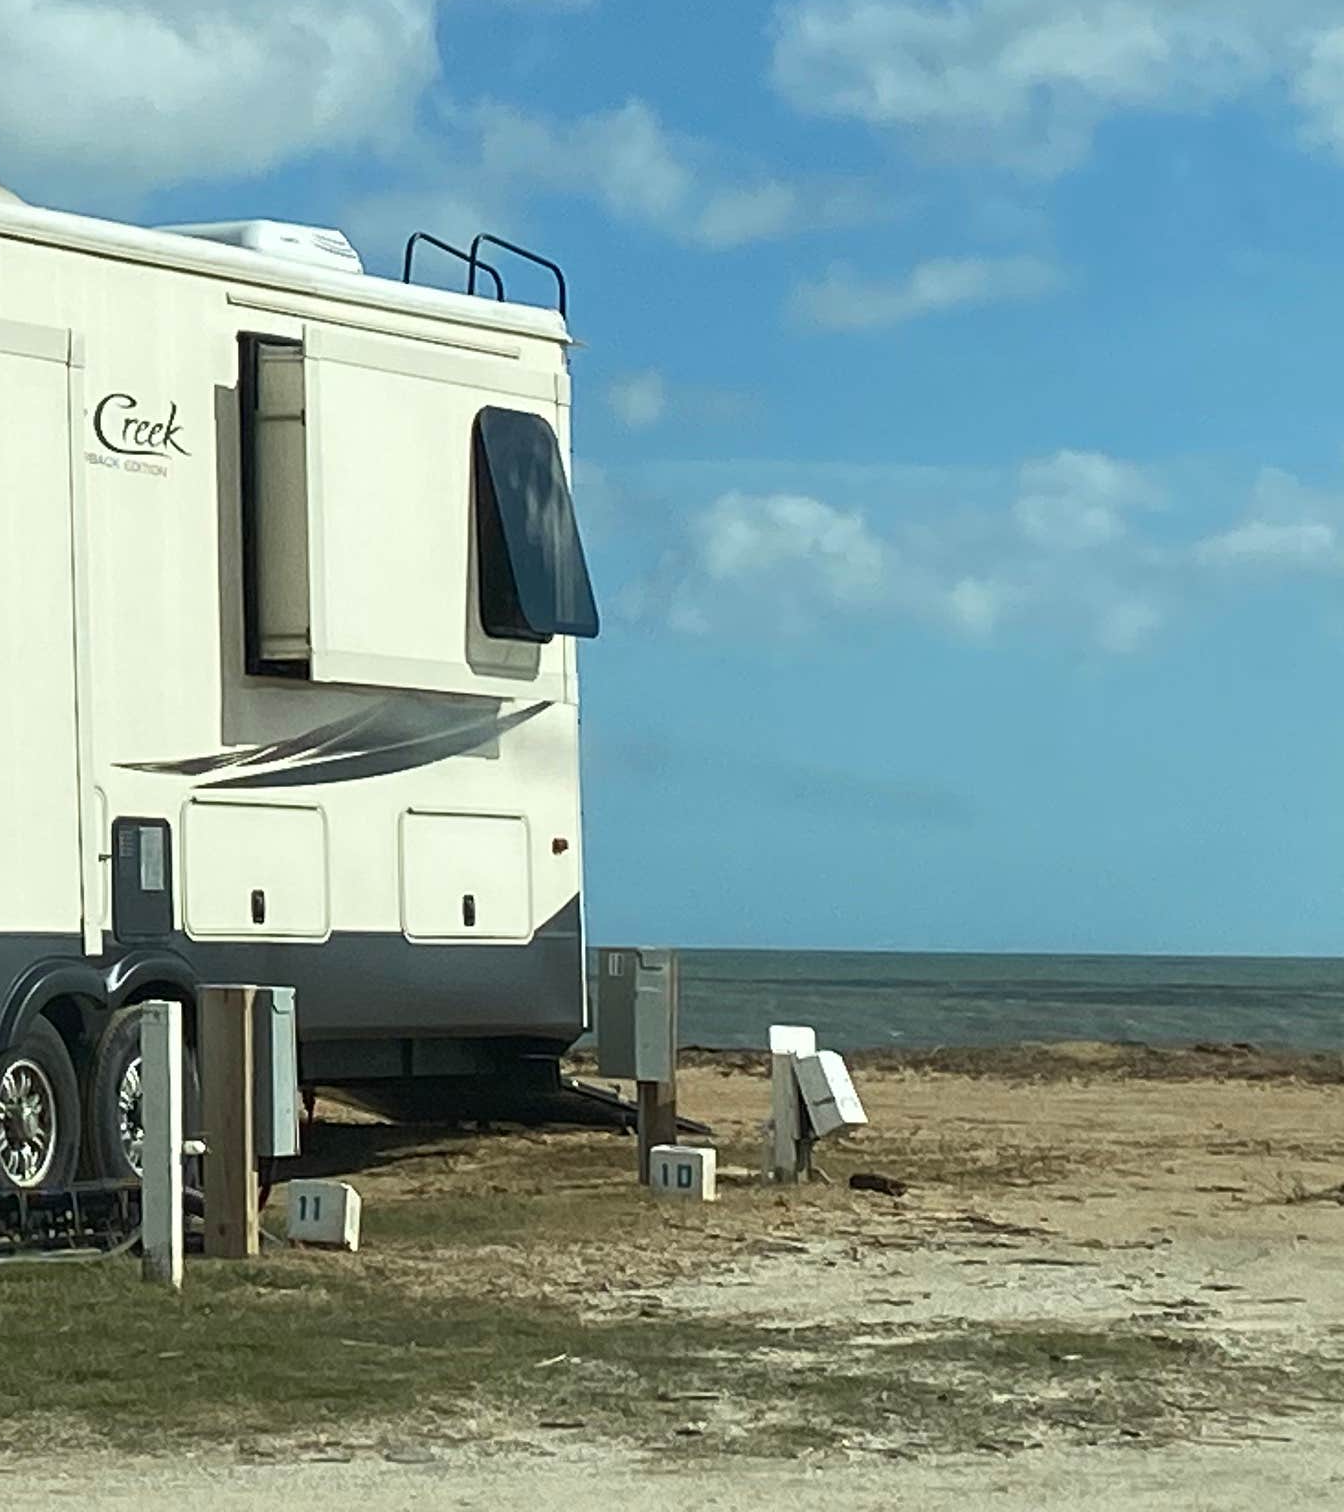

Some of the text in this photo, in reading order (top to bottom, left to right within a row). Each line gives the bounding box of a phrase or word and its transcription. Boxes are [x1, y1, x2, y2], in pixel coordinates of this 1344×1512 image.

[93, 393, 192, 460] Creek
[663, 1162, 692, 1188] 10
[299, 1195, 321, 1221] 11
